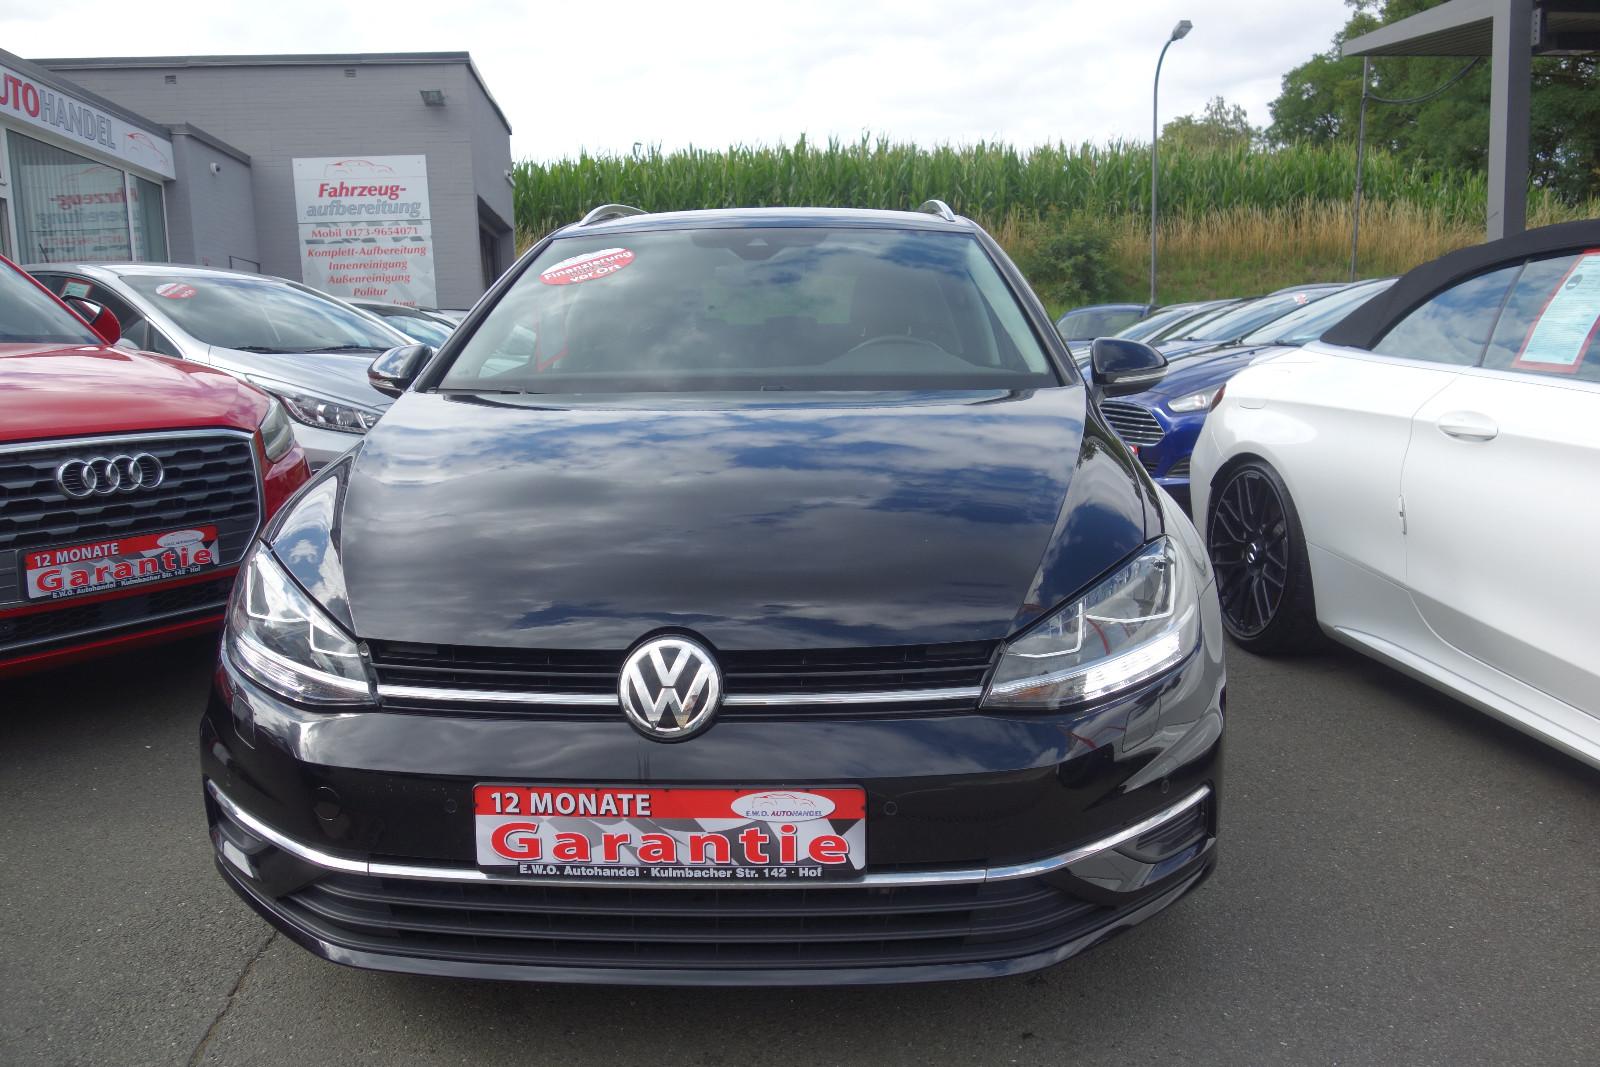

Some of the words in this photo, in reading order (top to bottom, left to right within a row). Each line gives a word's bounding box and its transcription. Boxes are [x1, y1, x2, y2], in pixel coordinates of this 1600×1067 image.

[318, 181, 407, 200] Fahrzeug-
[306, 199, 421, 218] aufbereitung
[311, 228, 341, 238] Mobil
[346, 226, 418, 237] 0173-9654071
[307, 245, 426, 259] Komplett-Aufbereitung
[329, 259, 408, 271] Innenreinigung
[543, 251, 632, 280] Finanzierung
[596, 263, 621, 274] Ort
[328, 273, 411, 285] Außenreinigung
[353, 286, 388, 297] Politur
[34, 555, 51, 567] 12
[56, 543, 119, 564] MONATE
[36, 545, 213, 592] Garantie
[491, 792, 520, 814] 12
[530, 792, 652, 816] MONATE
[490, 821, 850, 865] Garantie
[519, 865, 560, 875] E.W.O.
[564, 866, 639, 877] Autohandel
[651, 867, 733, 878] Kulmbacher
[736, 867, 759, 878] Str.
[763, 867, 787, 877] 142
[799, 866, 823, 877] Hof
